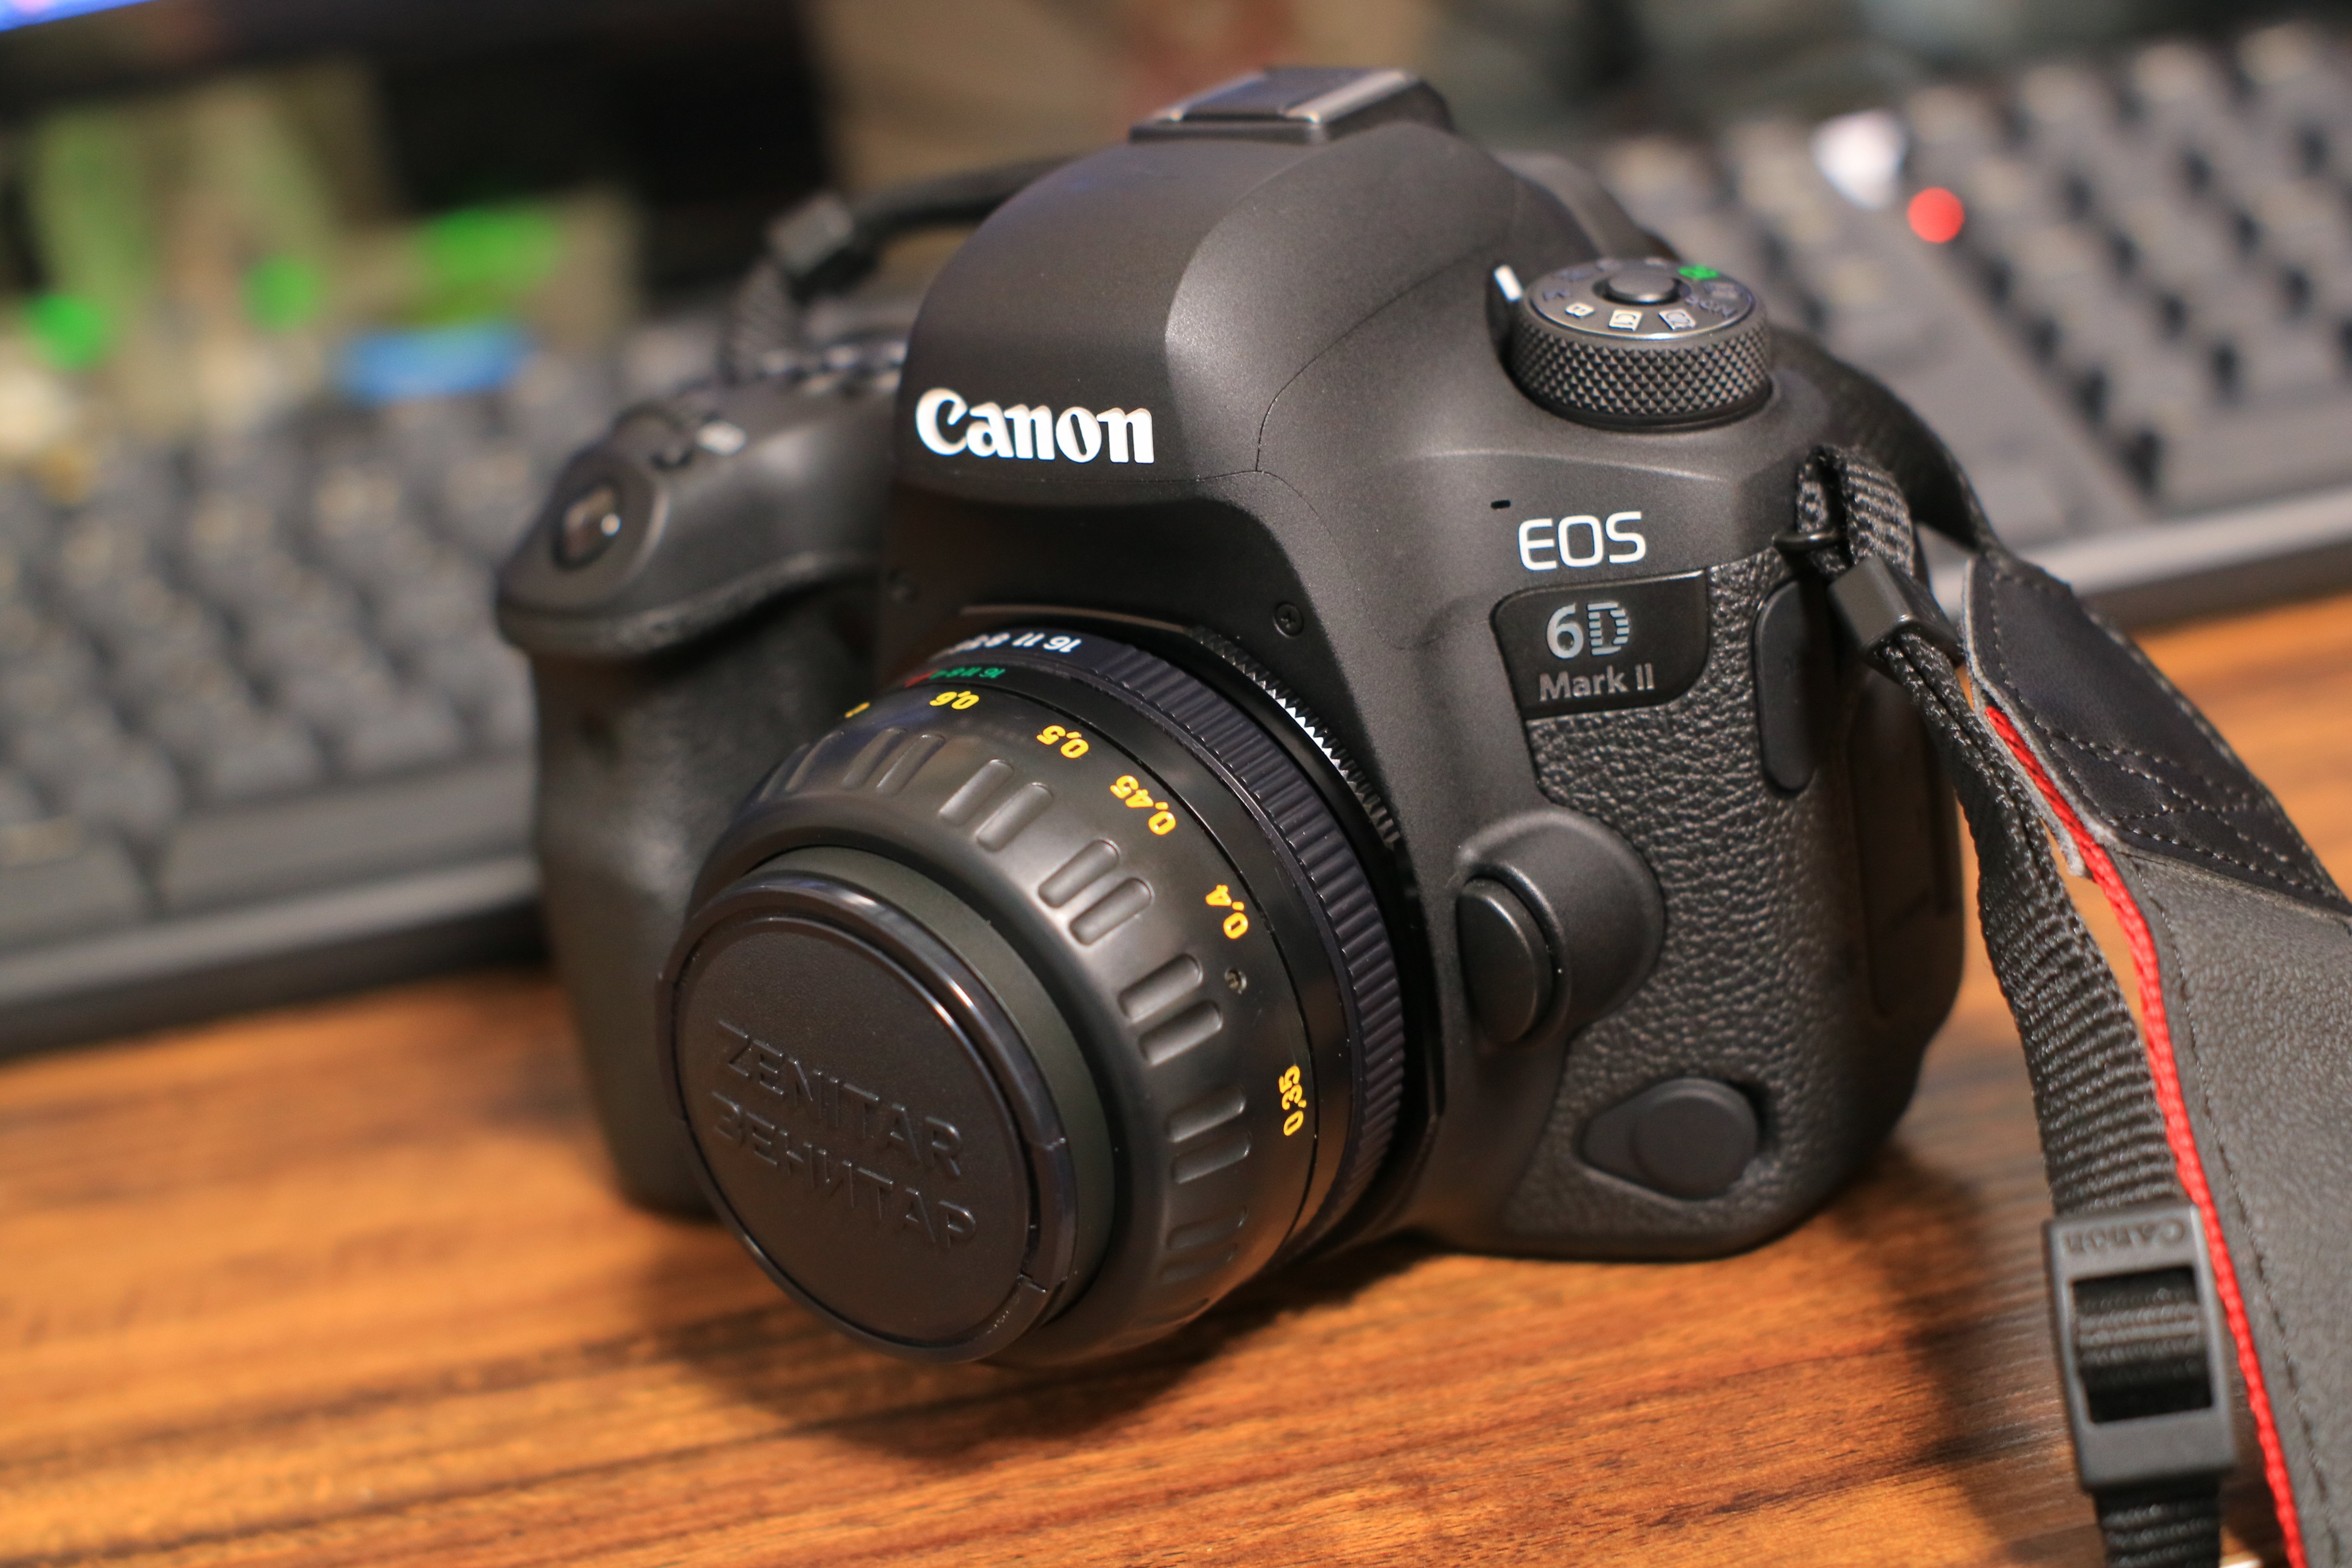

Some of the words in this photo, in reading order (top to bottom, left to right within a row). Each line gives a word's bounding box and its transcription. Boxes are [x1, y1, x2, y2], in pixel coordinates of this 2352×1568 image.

[1610, 309, 1642, 331] C1
[916, 388, 1154, 464] Canon
[1518, 511, 1646, 571] EOS
[1012, 633, 1045, 648] 11
[1043, 635, 1081, 653] 16
[1546, 601, 1630, 659] 6D
[929, 691, 980, 710] 0,6
[1539, 664, 1629, 702] Mark
[1635, 662, 1655, 691] II
[1036, 725, 1089, 759] 0,5
[1109, 774, 1178, 836] 0,45
[1205, 884, 1249, 939] 0,4
[718, 1020, 961, 1175] ZENITAR
[1278, 1064, 1307, 1136] 0,35
[712, 1091, 976, 1248] ЗЕНИТАР
